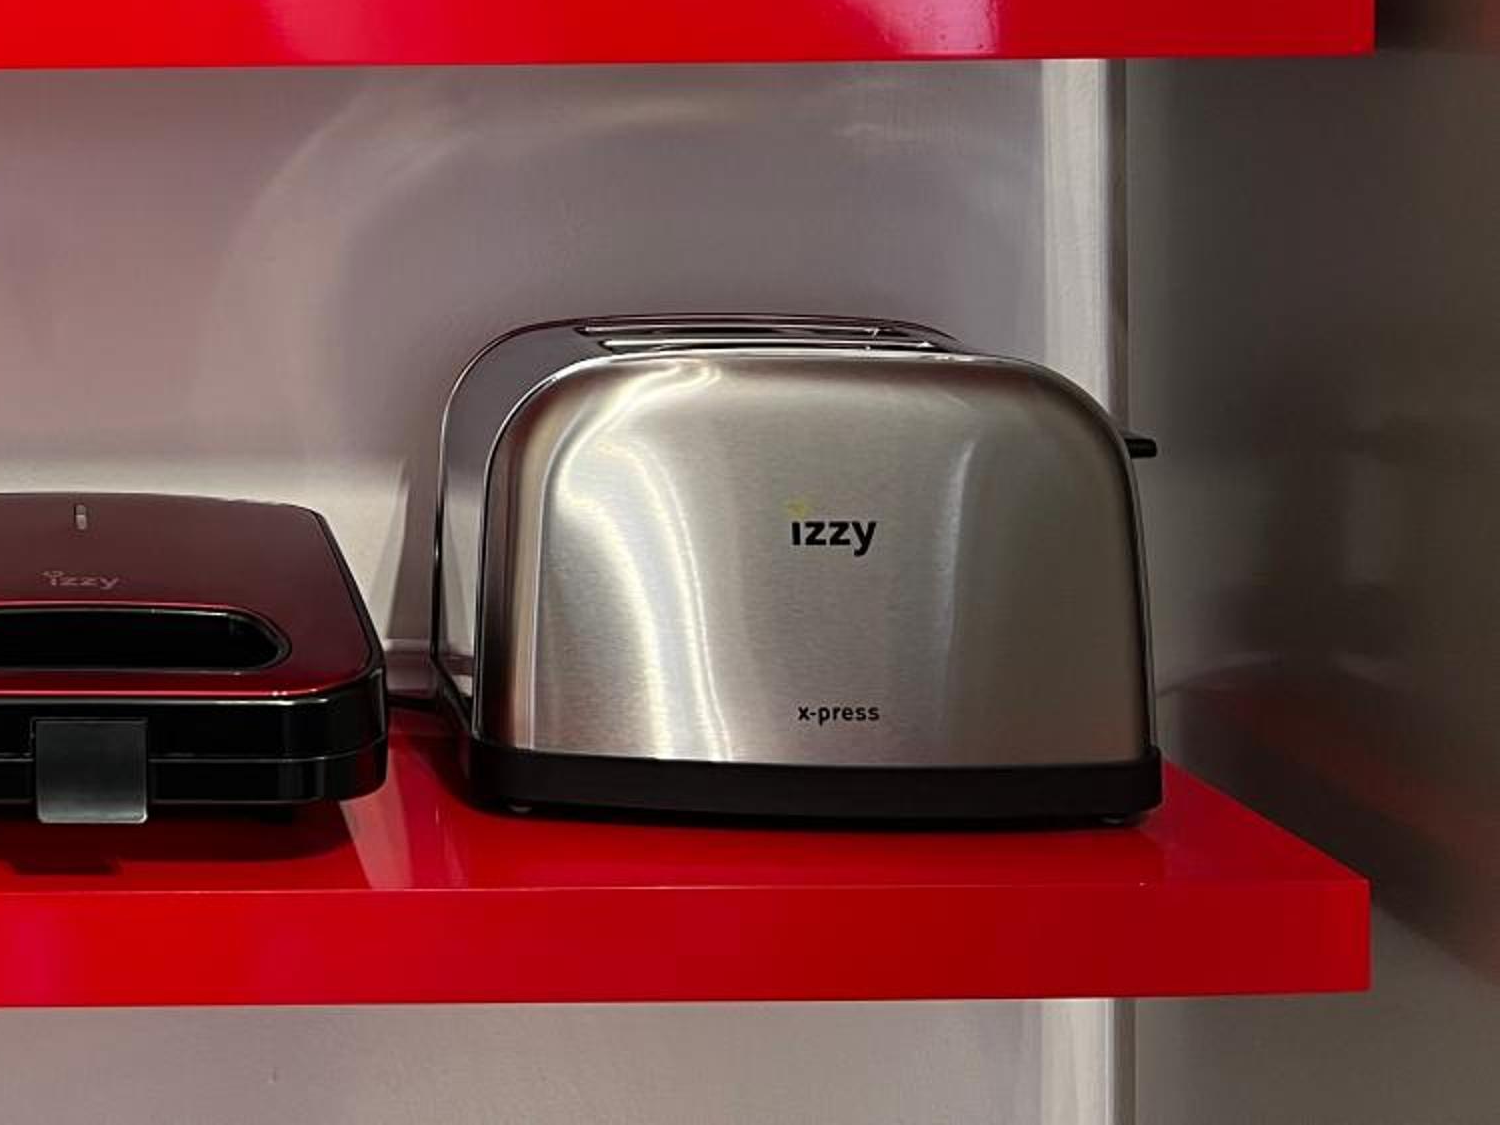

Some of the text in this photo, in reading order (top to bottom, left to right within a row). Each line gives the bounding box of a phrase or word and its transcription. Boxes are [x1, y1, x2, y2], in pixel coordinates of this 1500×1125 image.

[790, 521, 877, 557] izzy
[43, 570, 120, 591] izzy
[797, 706, 880, 726] x-press
